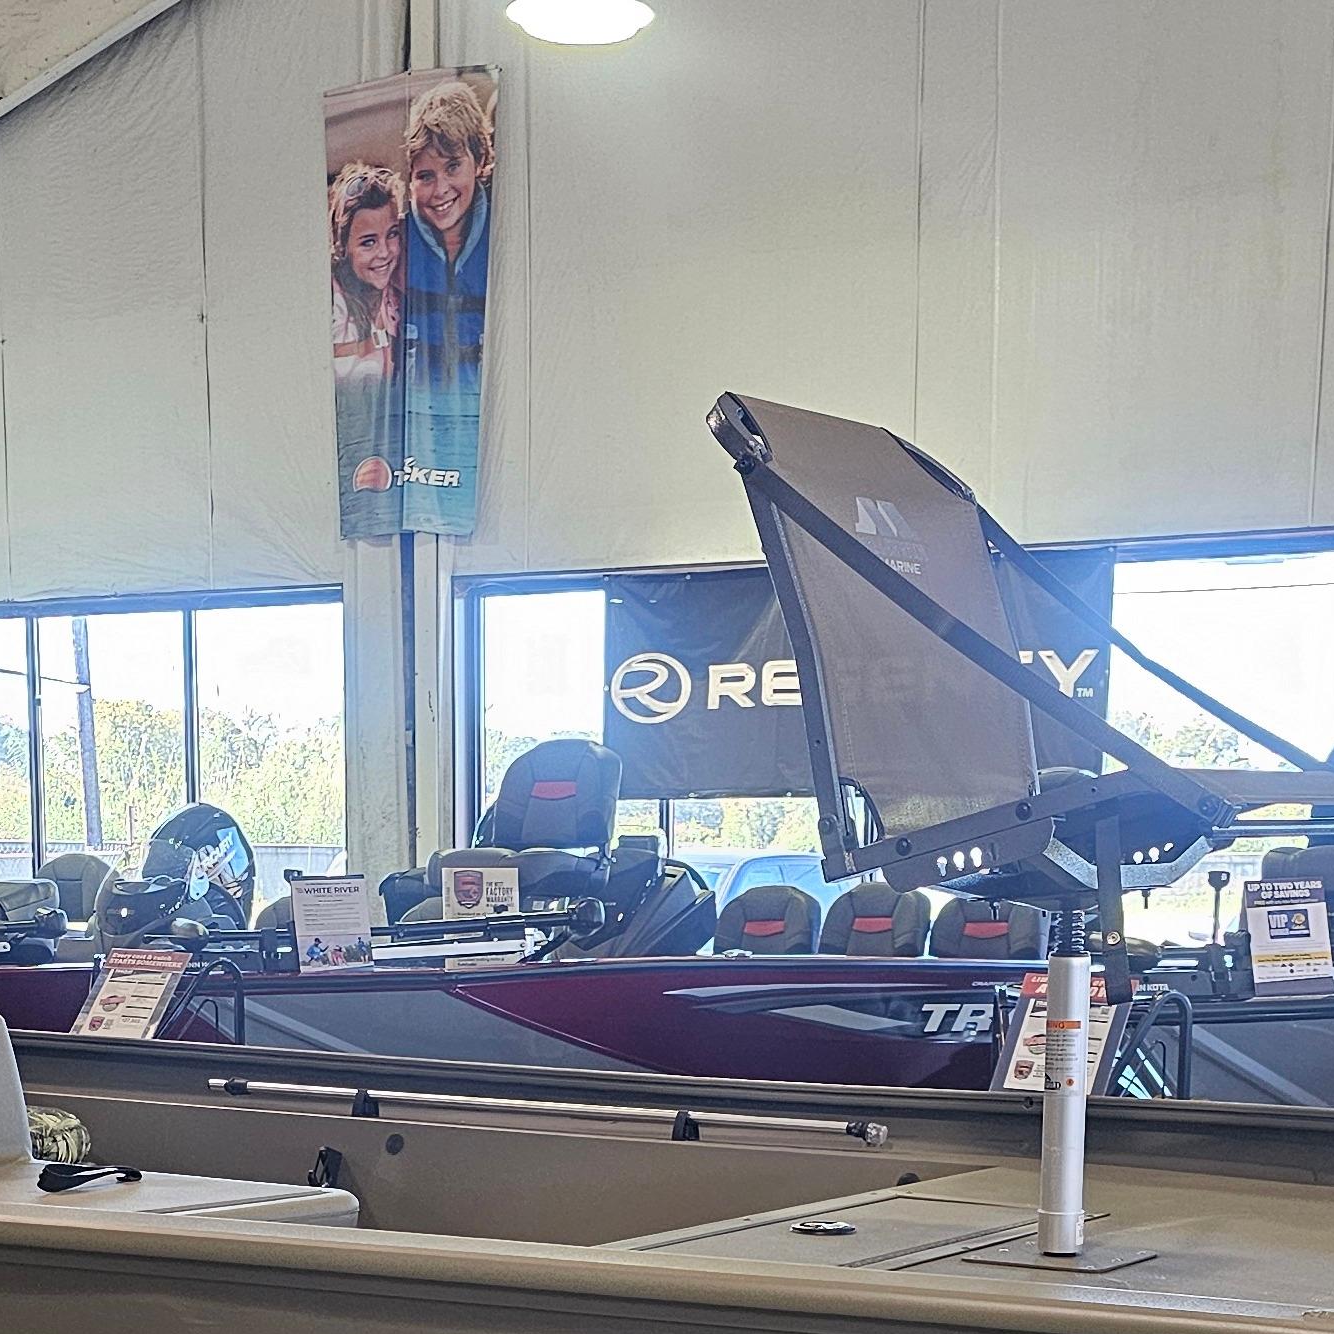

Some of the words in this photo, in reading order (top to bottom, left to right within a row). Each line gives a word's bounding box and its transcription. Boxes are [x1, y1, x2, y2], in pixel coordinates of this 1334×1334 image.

[1248, 883, 1260, 891] UP
[1274, 882, 1293, 890] TWO
[1293, 881, 1323, 889] YEARS
[1261, 891, 1273, 899] OF
[1274, 890, 1310, 899] SAVINGS
[1269, 914, 1288, 928] VIP
[136, 960, 183, 968] SOMEWHERE
